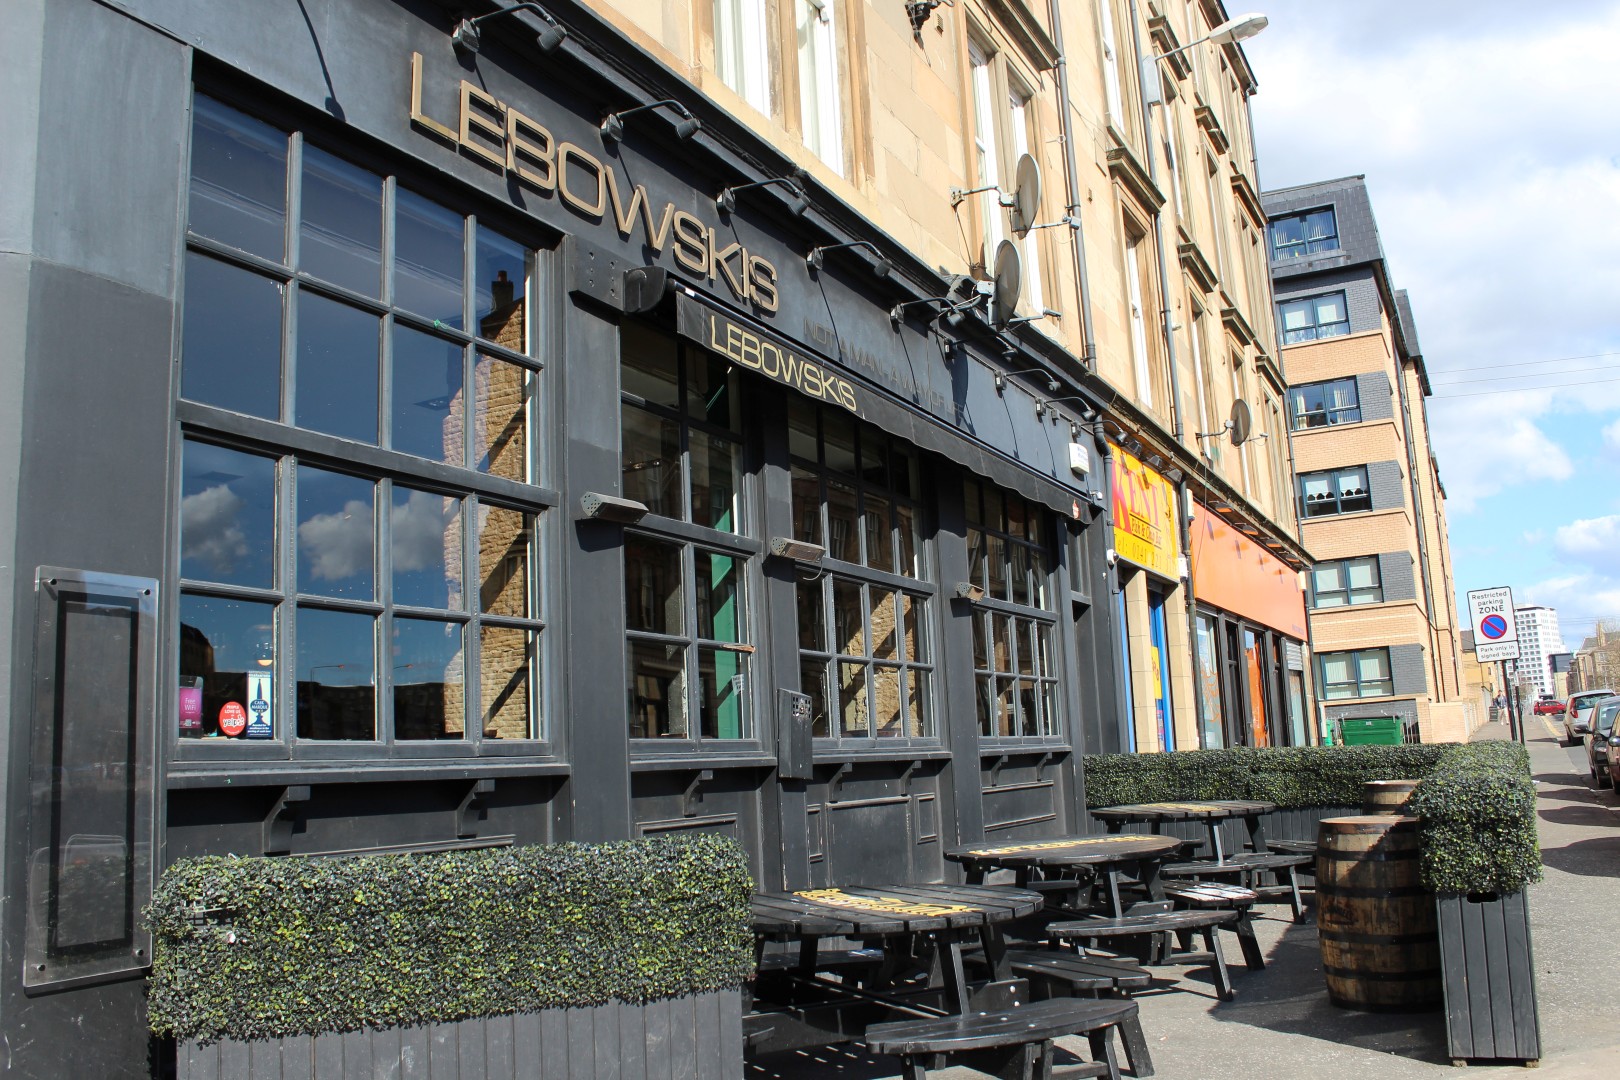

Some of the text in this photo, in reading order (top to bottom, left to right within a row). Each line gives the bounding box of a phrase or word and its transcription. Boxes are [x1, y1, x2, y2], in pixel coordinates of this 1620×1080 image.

[410, 51, 779, 312] LEBOWSKIS
[804, 317, 835, 349] NOT
[708, 315, 857, 412] LEBOWSKIS
[1471, 591, 1507, 600] Restricted
[1478, 605, 1505, 614] ZONE
